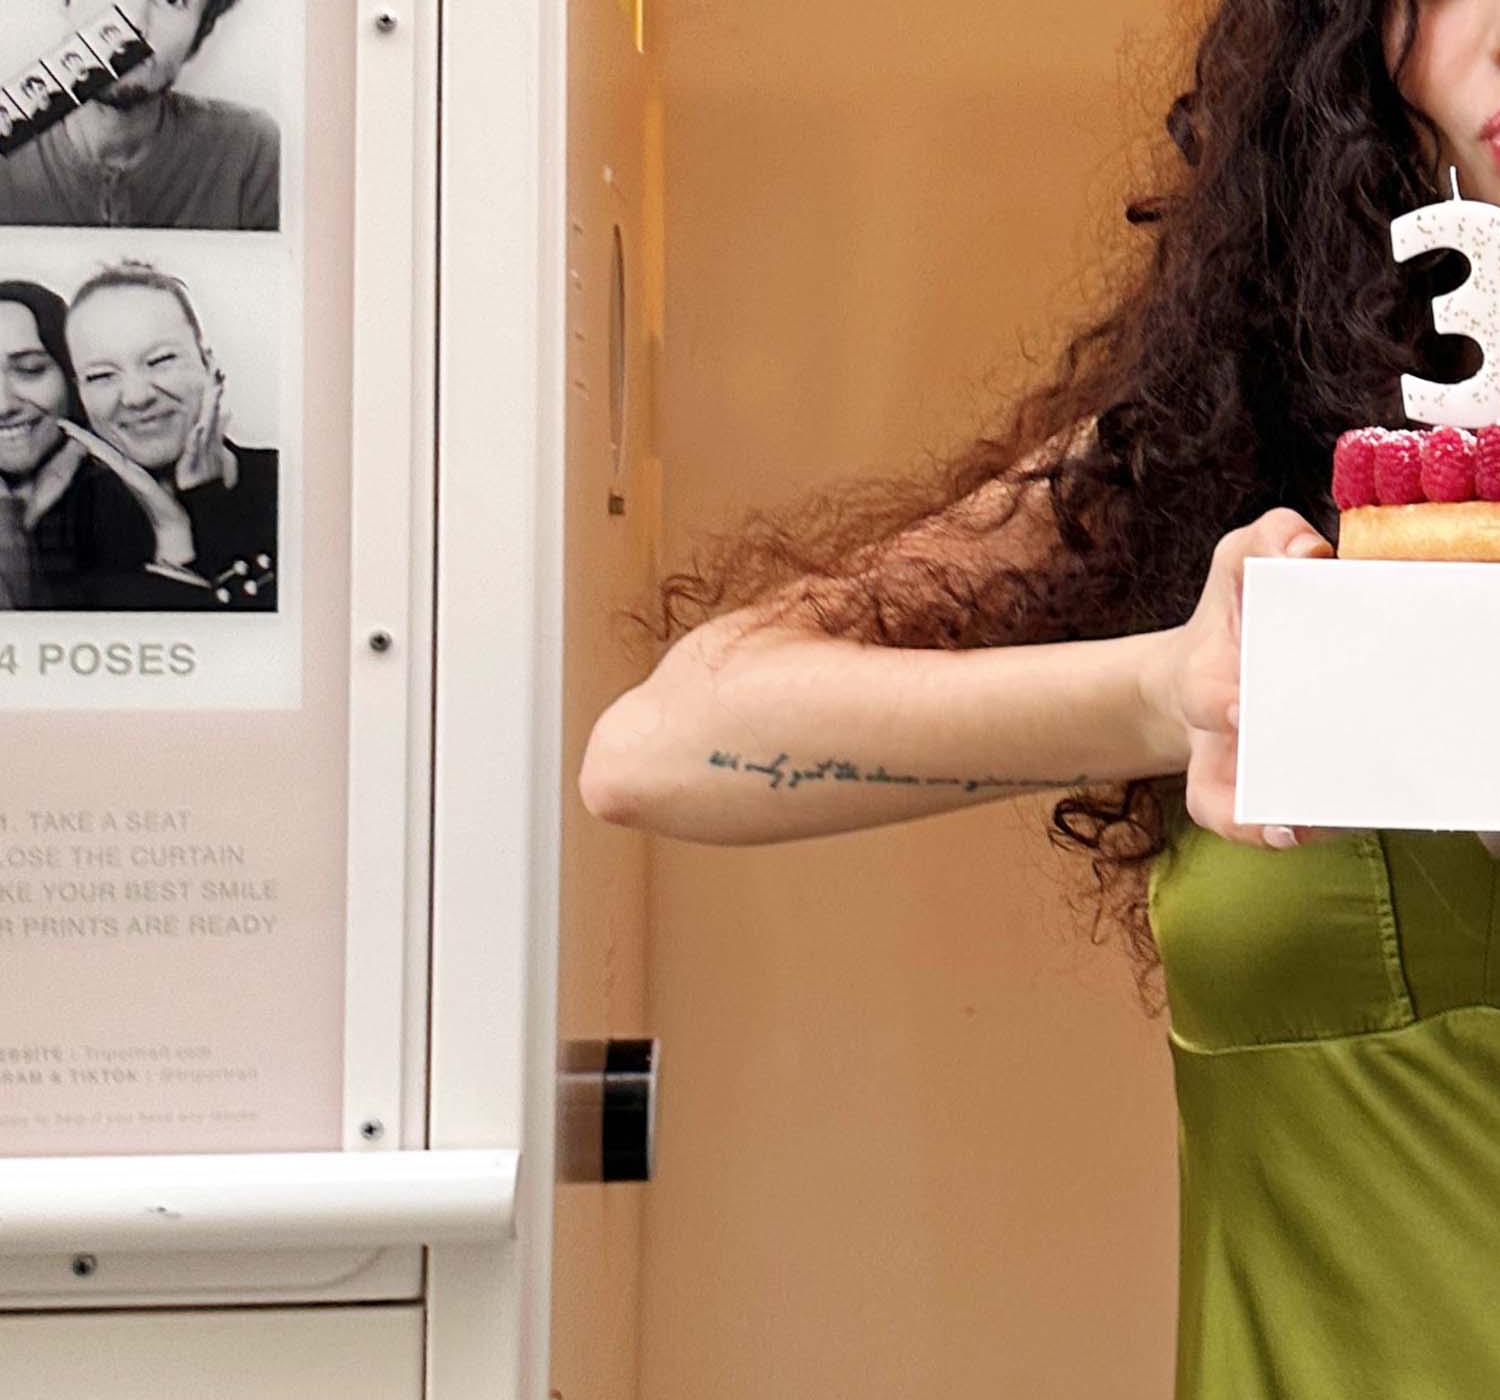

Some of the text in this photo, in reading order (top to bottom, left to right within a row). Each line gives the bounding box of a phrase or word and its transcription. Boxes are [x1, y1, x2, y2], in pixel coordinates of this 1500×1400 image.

[38, 642, 197, 677] POSES
[29, 810, 95, 833] TAKE
[102, 810, 119, 833] A
[126, 809, 192, 833] SEAT
[71, 846, 122, 867] THE
[130, 844, 246, 867] CURTAIN
[43, 880, 117, 903] YOUR
[125, 879, 192, 902] BEST
[201, 878, 279, 901] SMILE
[23, 916, 120, 938] PRINTS
[127, 915, 180, 937] ARE
[188, 913, 279, 936] READY
